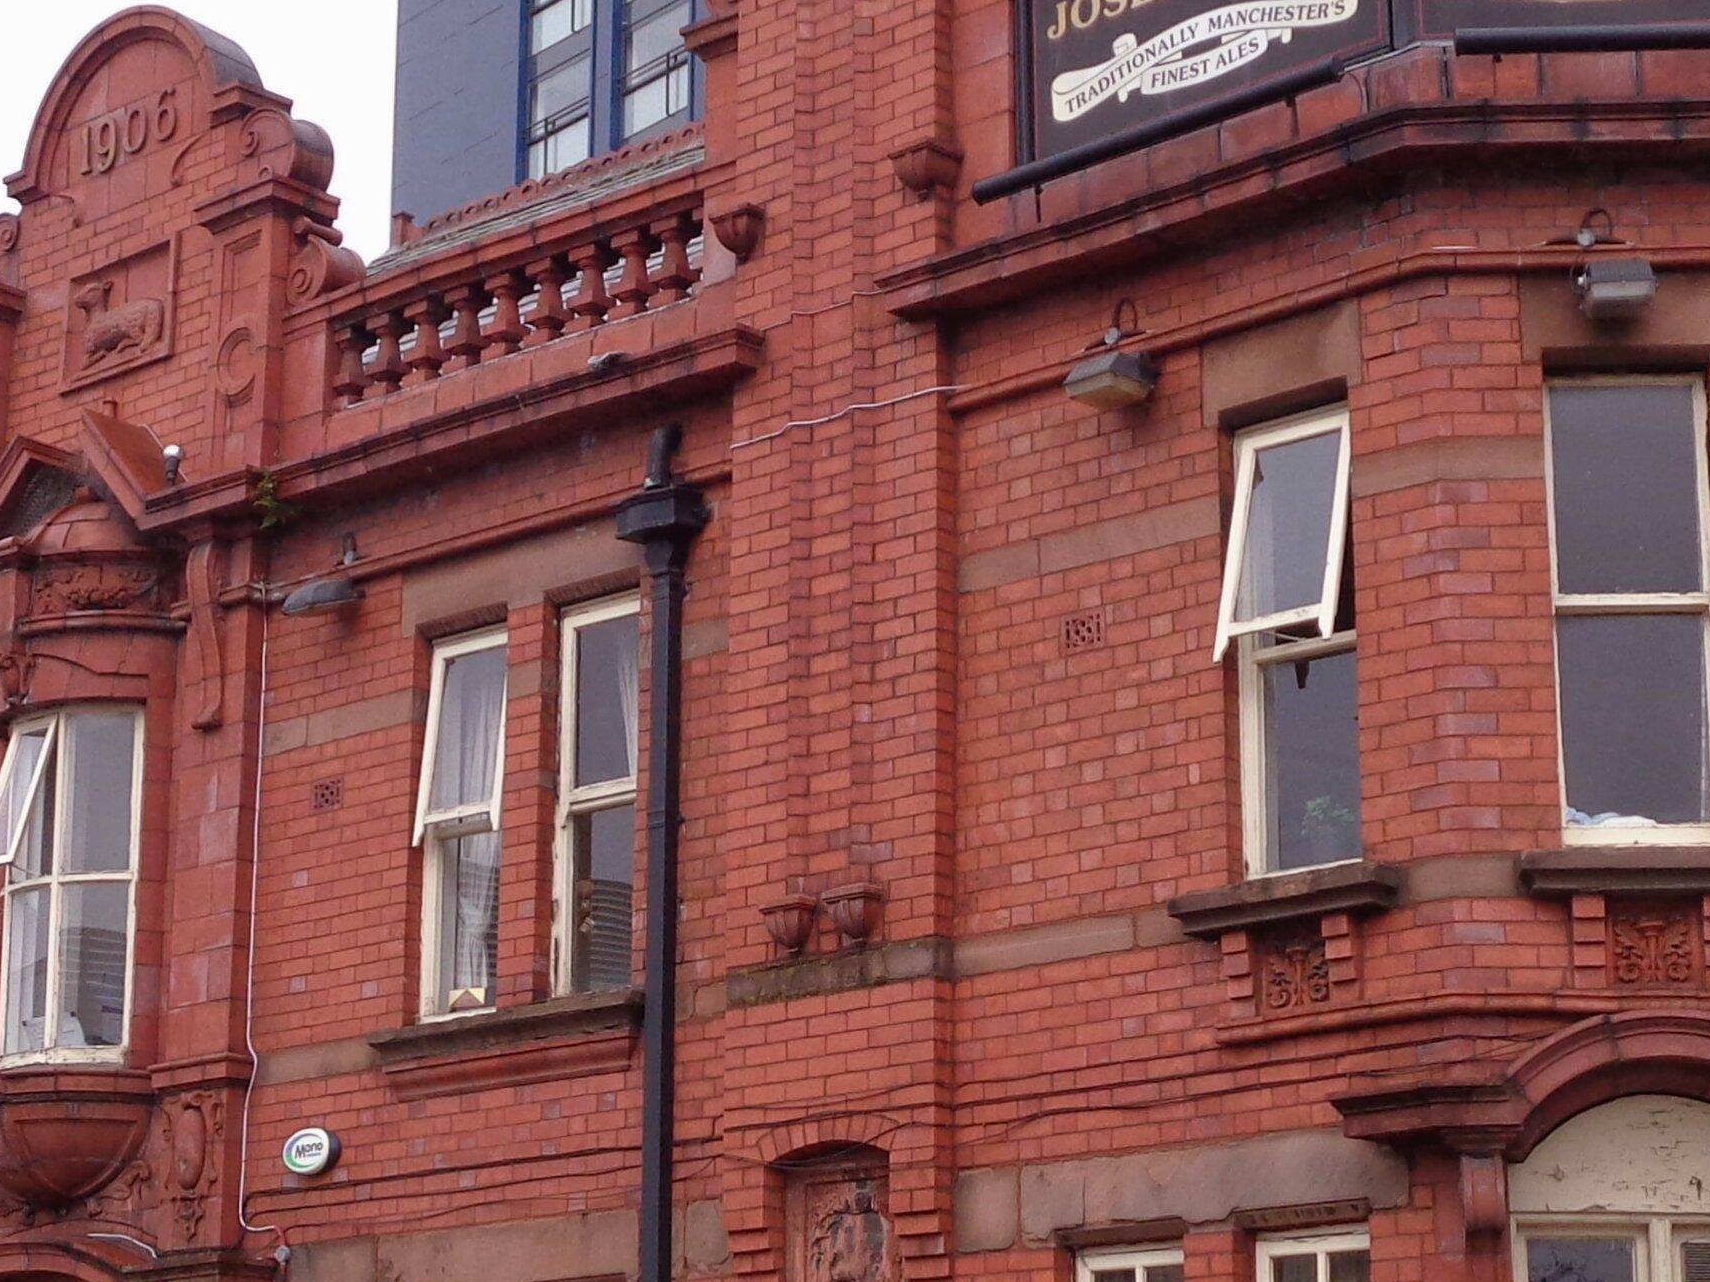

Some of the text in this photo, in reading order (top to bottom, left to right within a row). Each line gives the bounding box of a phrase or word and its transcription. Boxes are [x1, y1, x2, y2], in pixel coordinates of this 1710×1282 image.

[1064, 0, 1346, 114] TRADITIONALLY MANCHESTER'S
[1150, 37, 1260, 89] FINEST ALES
[80, 88, 178, 176] 1906
